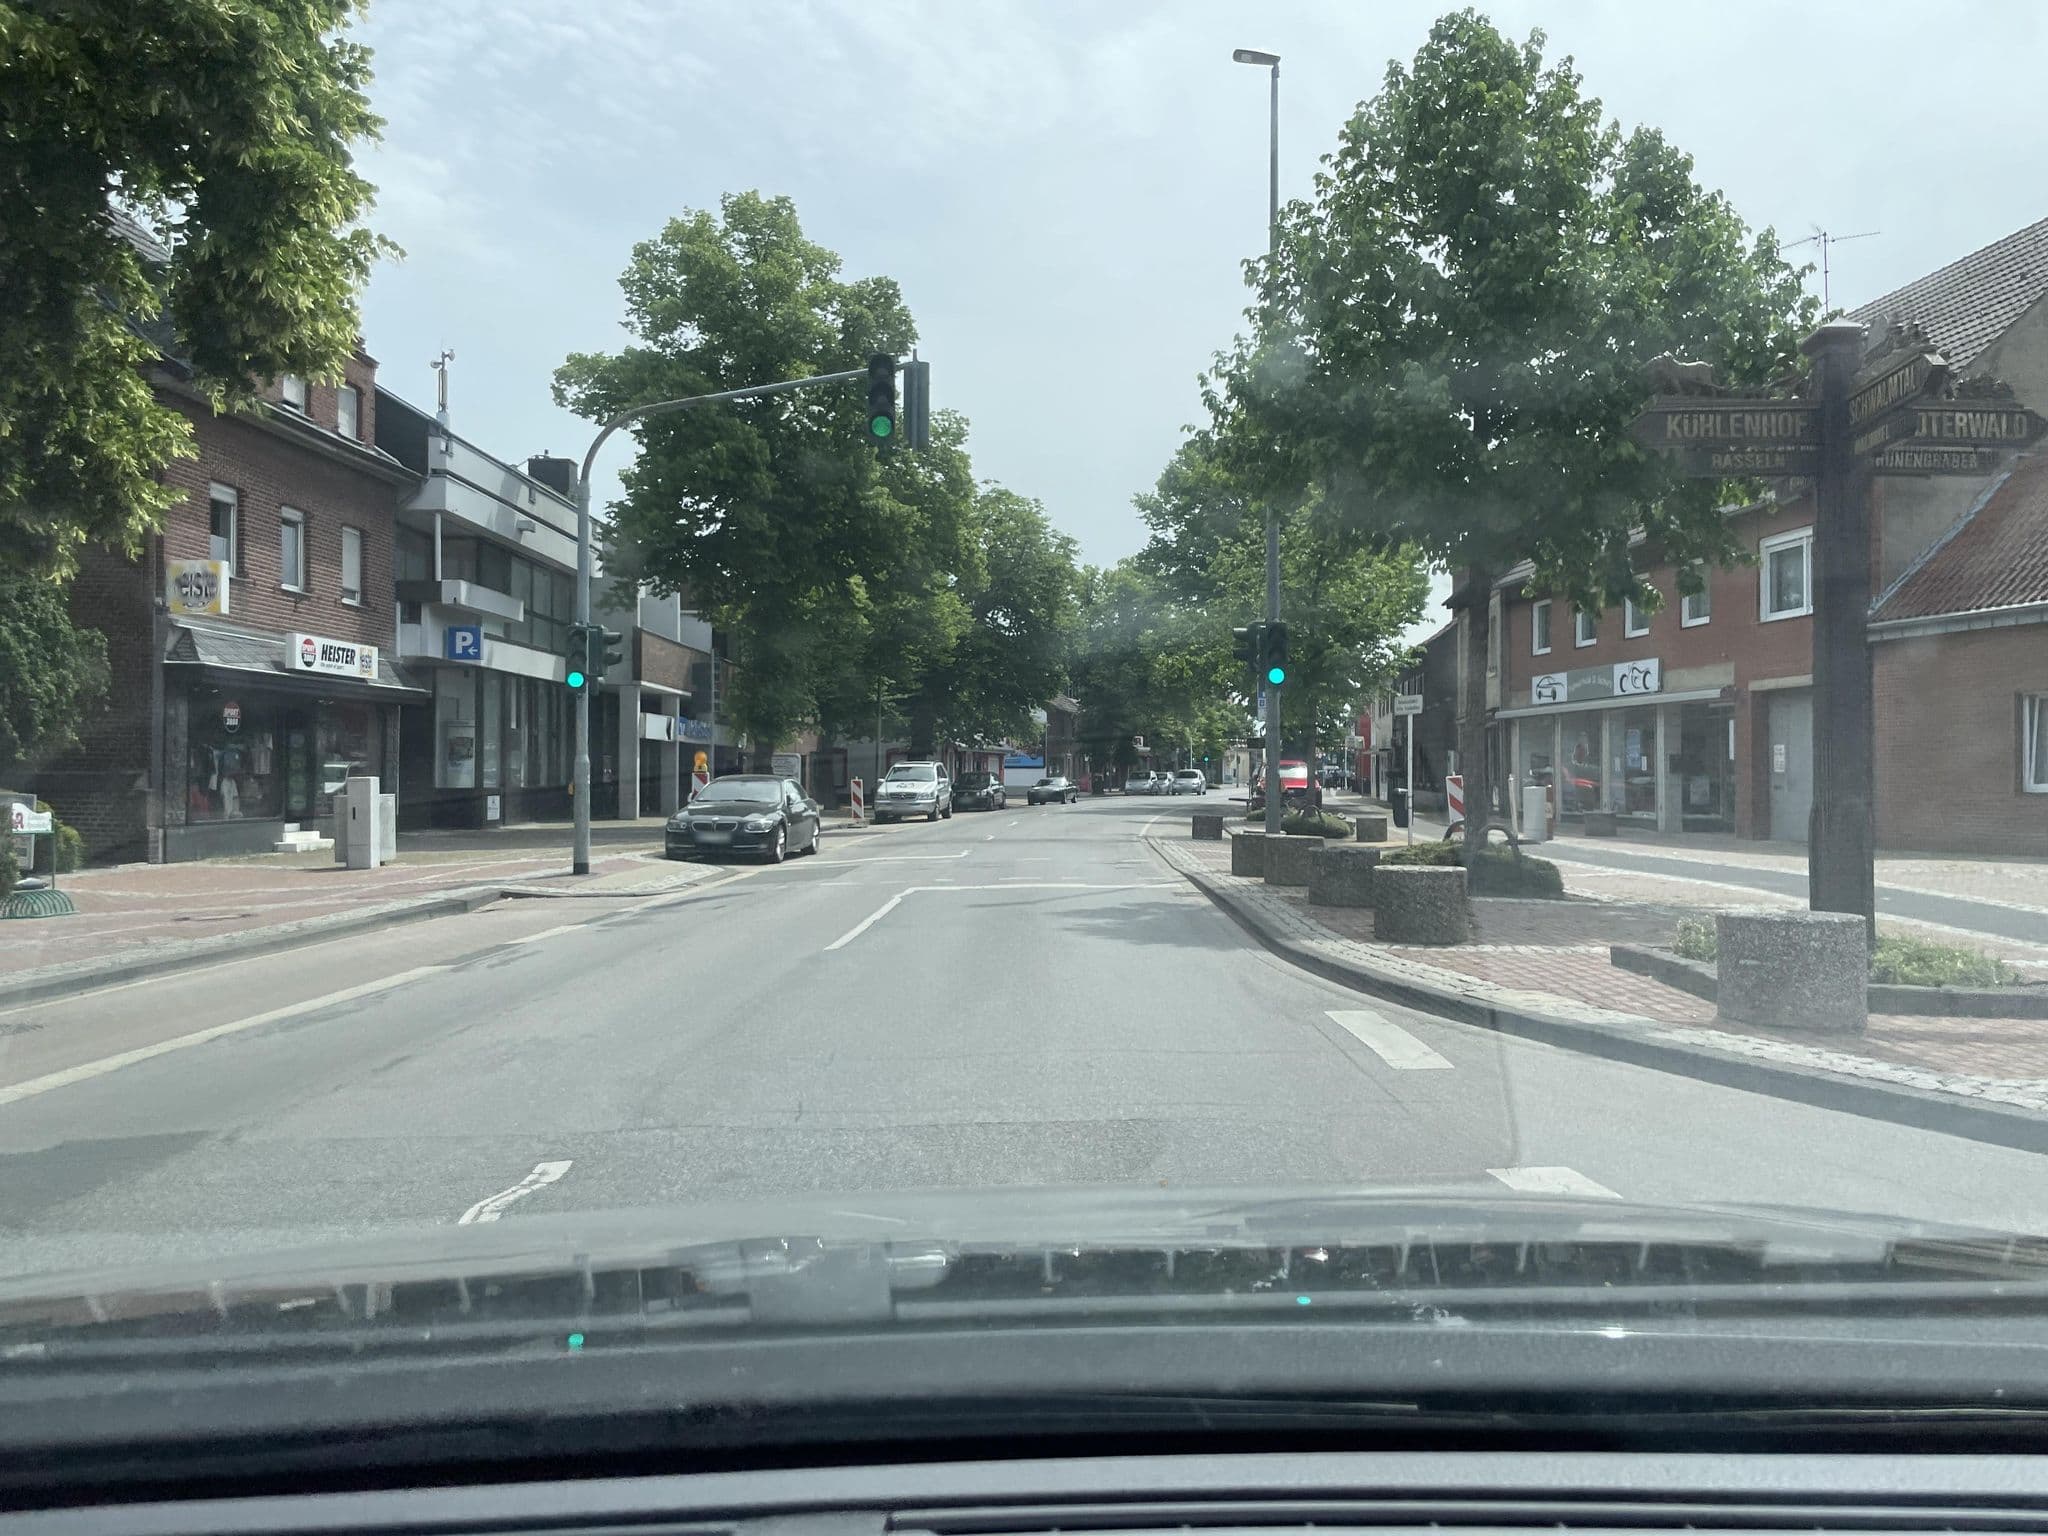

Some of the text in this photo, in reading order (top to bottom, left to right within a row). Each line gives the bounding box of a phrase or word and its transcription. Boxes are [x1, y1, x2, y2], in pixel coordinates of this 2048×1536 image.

[1850, 365, 1917, 425] SCHWALMTAL
[1666, 412, 1807, 439] KÜHLENHOF
[321, 643, 356, 665] HEISTER
[456, 631, 474, 654] P
